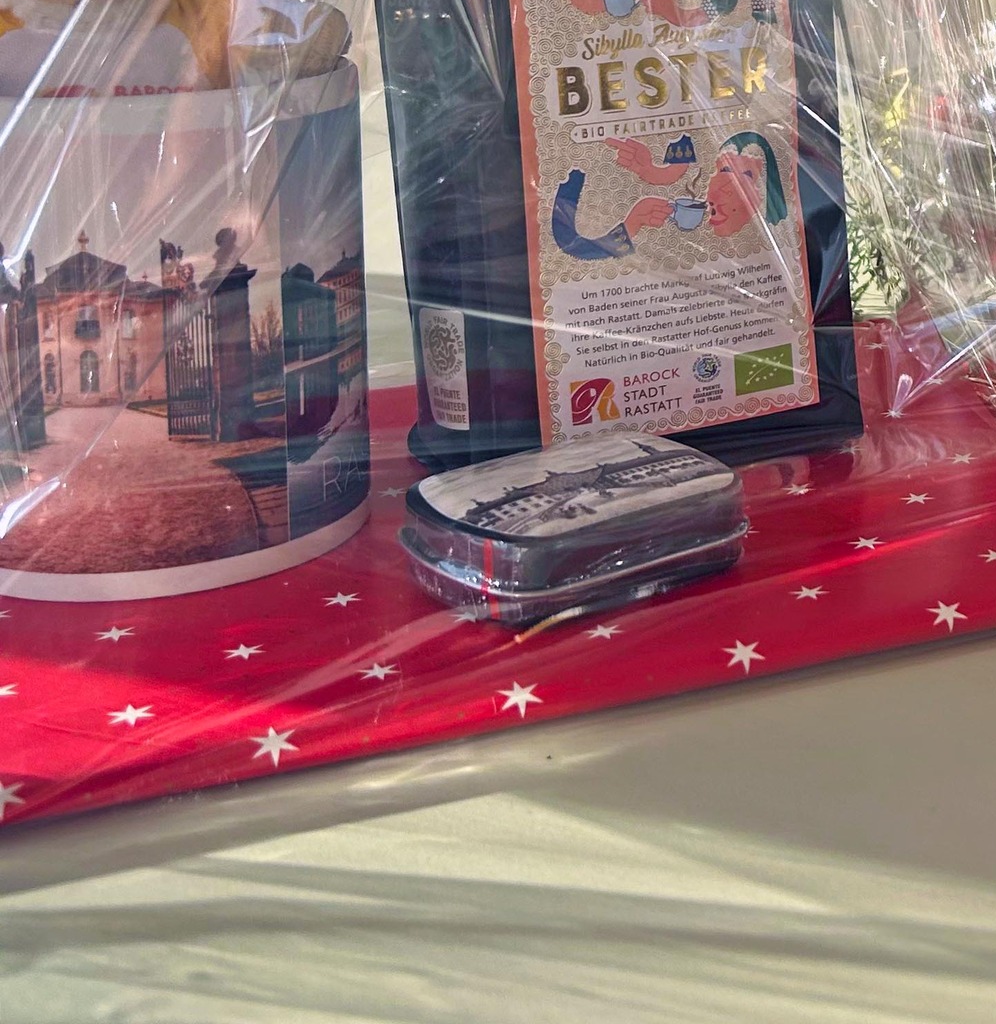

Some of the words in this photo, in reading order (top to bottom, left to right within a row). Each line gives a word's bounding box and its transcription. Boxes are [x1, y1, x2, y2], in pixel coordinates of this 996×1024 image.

[582, 29, 643, 60] Sibylla
[556, 46, 769, 118] BESTER
[582, 125, 605, 139] BIO
[614, 114, 694, 136] FAIRTRADE
[568, 306, 586, 315] von
[588, 302, 618, 313] Baden
[620, 298, 648, 309] seiner
[650, 293, 669, 305] Frau
[671, 288, 708, 301] Augusta
[739, 278, 756, 289] den
[756, 273, 783, 285] Kaffee
[581, 291, 598, 300] Um
[601, 286, 623, 297] 1700
[624, 281, 659, 295] brachte
[737, 262, 771, 276] Wilhelm
[565, 320, 581, 329] mit
[583, 316, 605, 327] nach
[608, 312, 643, 324] Rastatt.
[645, 305, 677, 319] Damals
[679, 299, 726, 313] zelebrierte
[571, 333, 590, 343] ihre
[675, 316, 694, 327] aufs
[695, 311, 729, 324] Liebste.
[730, 307, 755, 318] Heute
[576, 346, 590, 355] Sie
[592, 342, 618, 354] selbst
[620, 340, 630, 349] in
[632, 338, 650, 347] den
[651, 329, 691, 343] Rastatter
[693, 321, 742, 337] Hof-Genuss
[584, 354, 627, 368] Natürlich
[629, 352, 638, 361] in
[640, 342, 694, 360] Bio-Qualität
[695, 339, 713, 350] und
[715, 336, 730, 347] fair
[731, 328, 775, 345] gehandelt.
[623, 367, 681, 387] BAROCK
[623, 384, 667, 403] STADT
[624, 396, 683, 418] RASTATT
